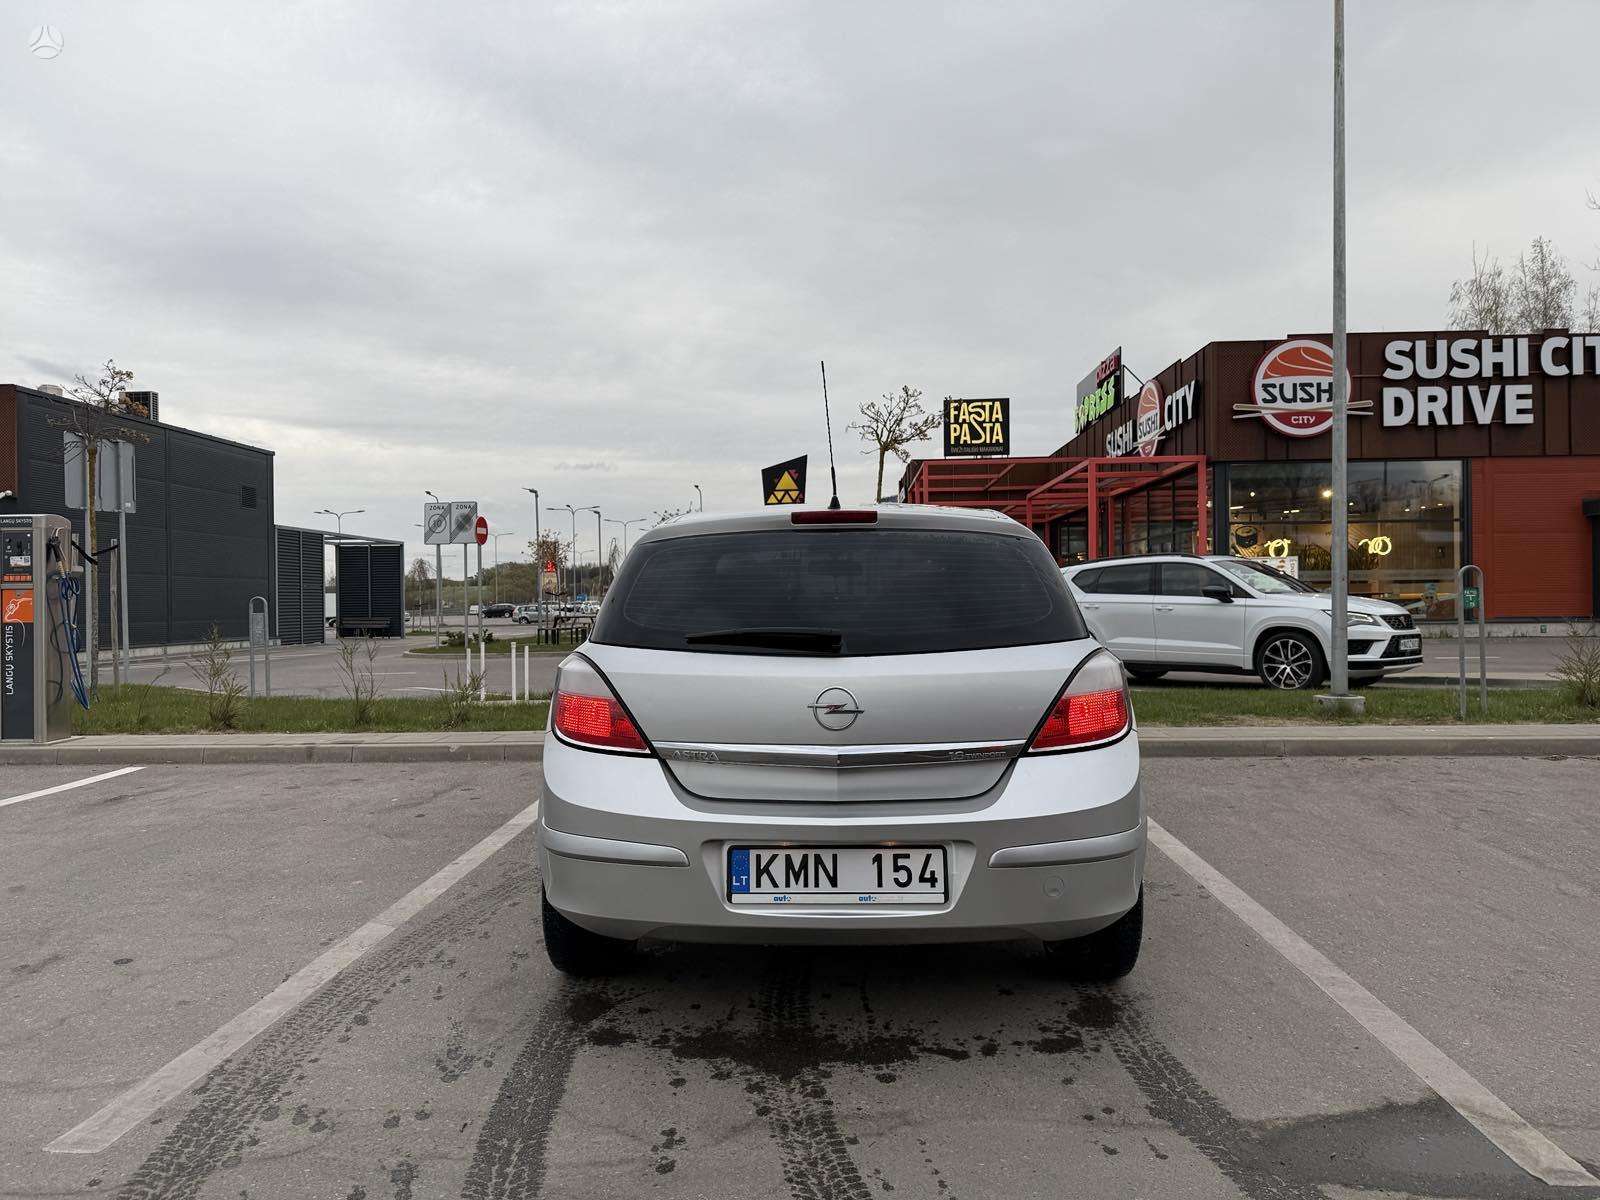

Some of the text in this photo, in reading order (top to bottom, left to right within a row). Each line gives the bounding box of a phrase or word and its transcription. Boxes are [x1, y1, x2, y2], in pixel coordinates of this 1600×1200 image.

[1382, 338, 1530, 380] SUSHI
[1261, 382, 1334, 404] SUSH
[1382, 384, 1534, 427] DRIVE
[949, 401, 1003, 423] FASTA
[1106, 379, 1196, 457] SUSHI CITY
[1291, 415, 1316, 424] CITY
[950, 422, 1003, 445] PASTA
[1138, 412, 1159, 439] SUSHI
[5, 625, 13, 661] SKYSTIS
[672, 750, 720, 761] ASTRA
[732, 876, 748, 886] LT
[755, 853, 938, 888] KMN 154
